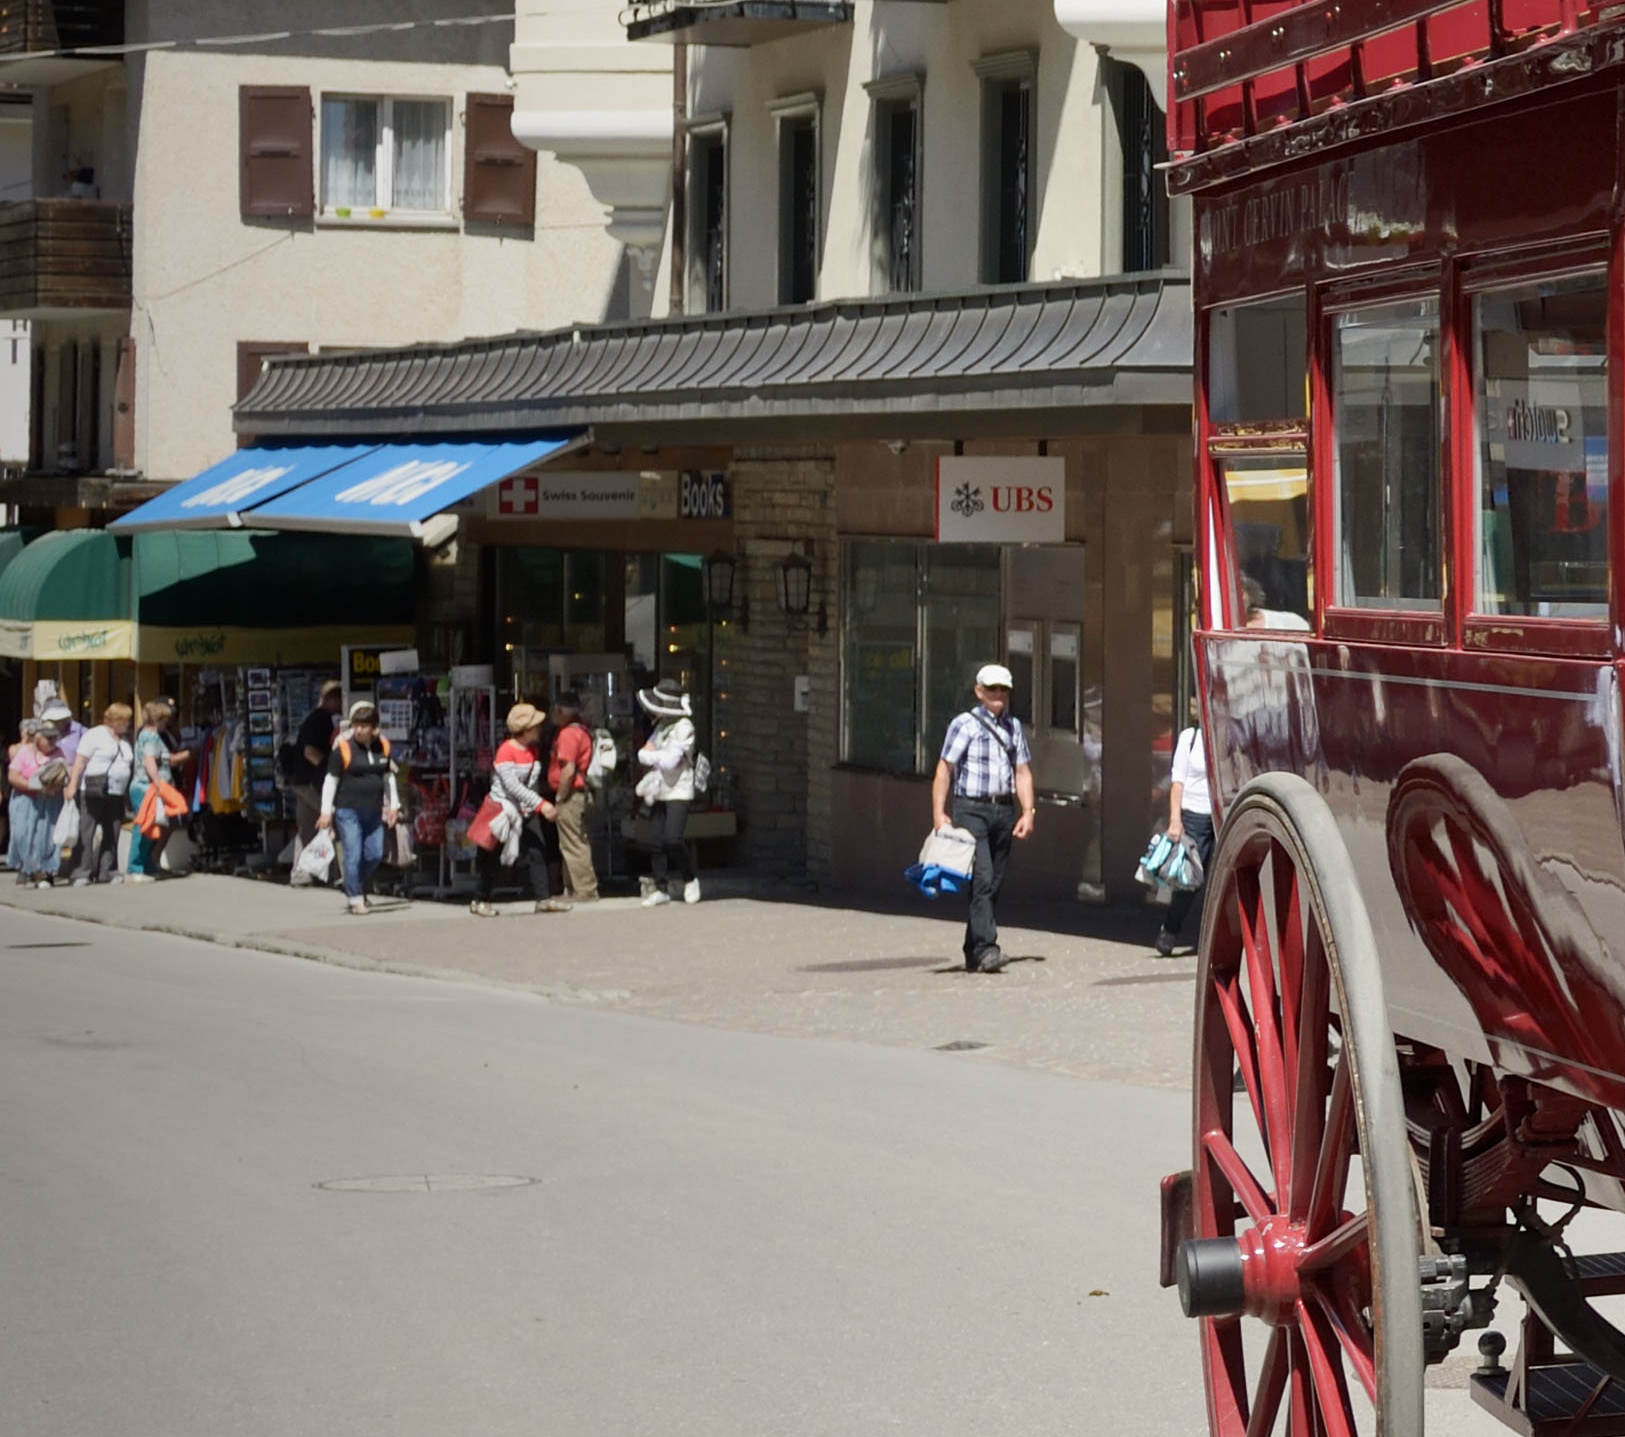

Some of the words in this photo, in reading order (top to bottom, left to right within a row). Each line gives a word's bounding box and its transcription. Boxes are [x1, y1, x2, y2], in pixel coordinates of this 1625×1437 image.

[1243, 186, 1296, 248] CERVIN
[542, 489, 578, 502] Swiss
[579, 488, 637, 502] Souvenir
[680, 472, 725, 518] Books
[990, 485, 1054, 514] UBS
